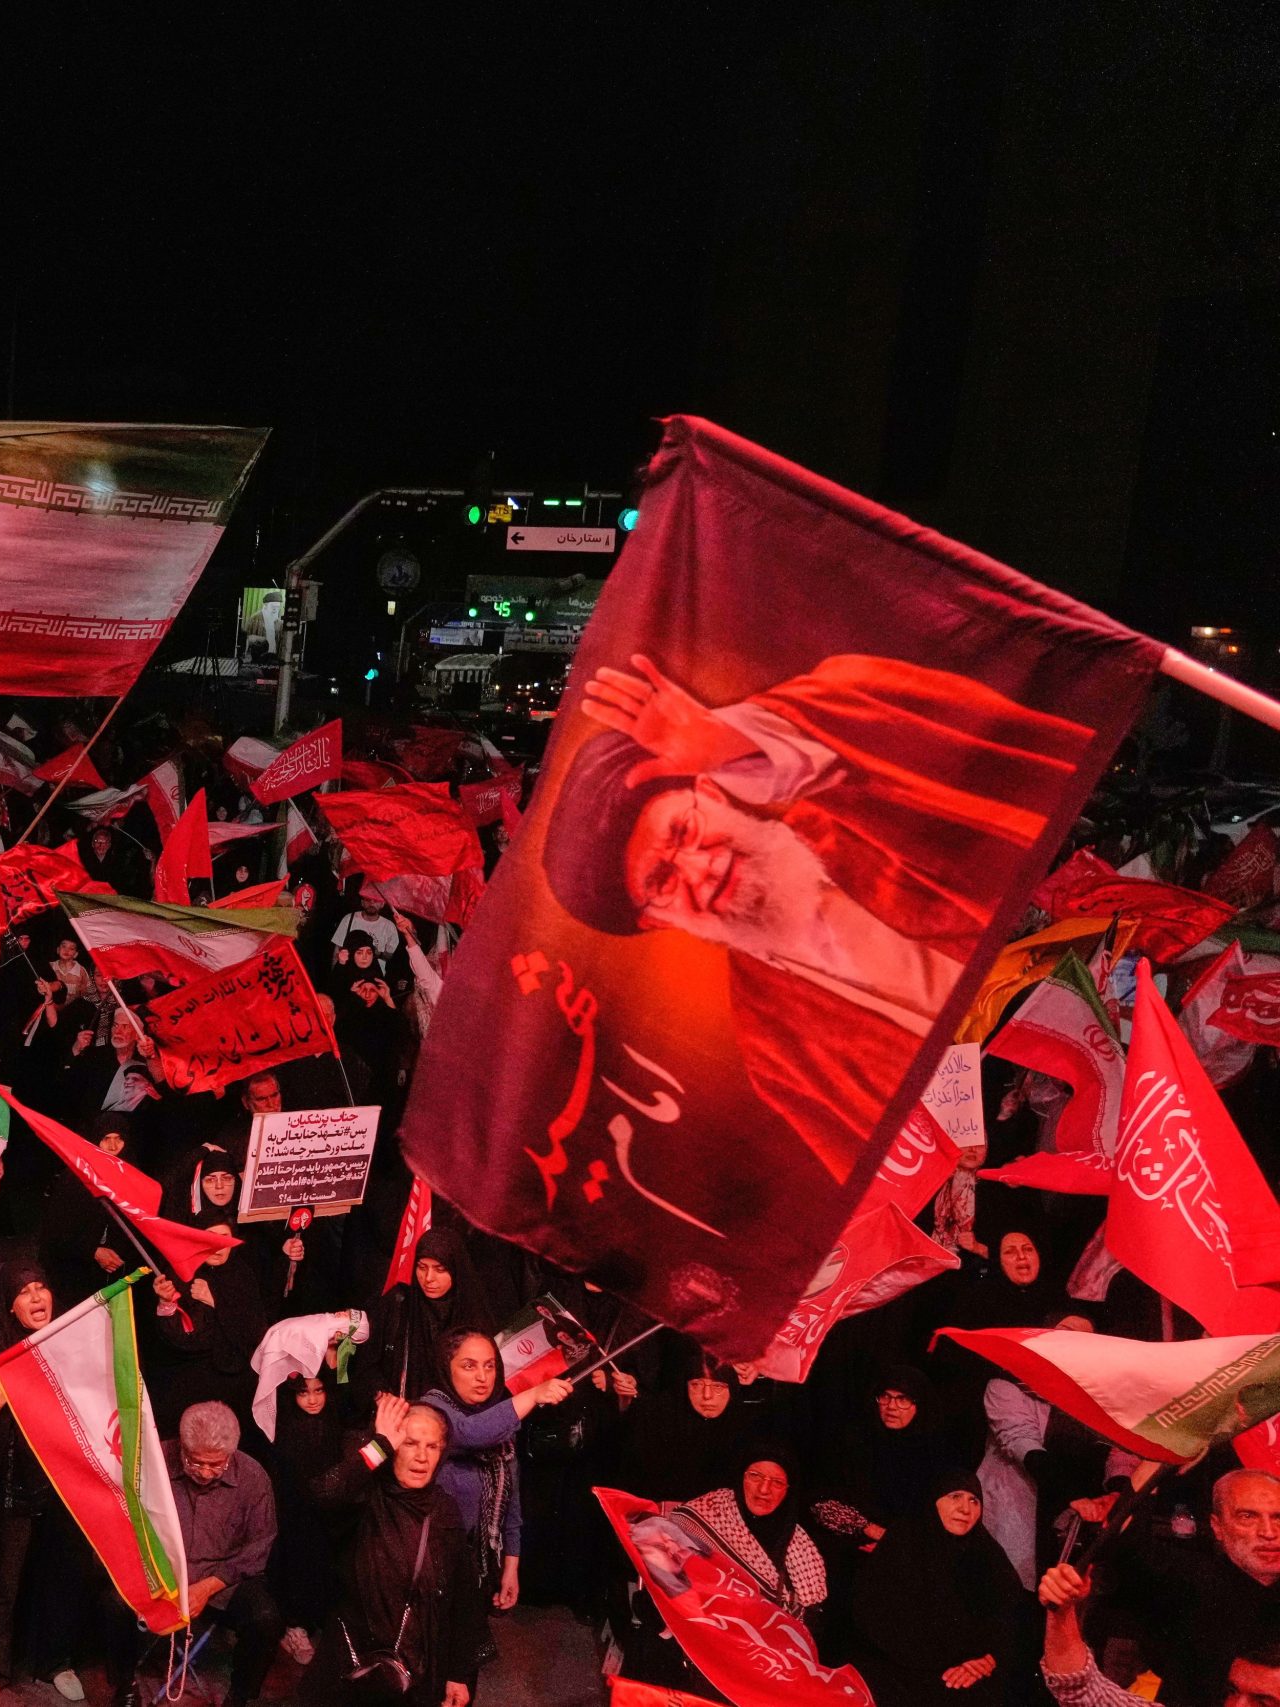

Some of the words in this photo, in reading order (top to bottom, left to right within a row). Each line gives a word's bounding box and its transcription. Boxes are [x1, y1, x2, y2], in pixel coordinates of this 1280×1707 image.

[556, 533, 602, 546] ستارخان
[493, 602, 511, 617] 45
[237, 977, 255, 991] یا
[330, 1111, 358, 1126] جناب
[349, 1127, 368, 1139] پس
[306, 1144, 336, 1158] رهبر
[340, 1140, 365, 1151] ملت
[306, 1163, 322, 1175] باید
[321, 1161, 345, 1174] جمهور
[309, 1190, 337, 1201] هست
